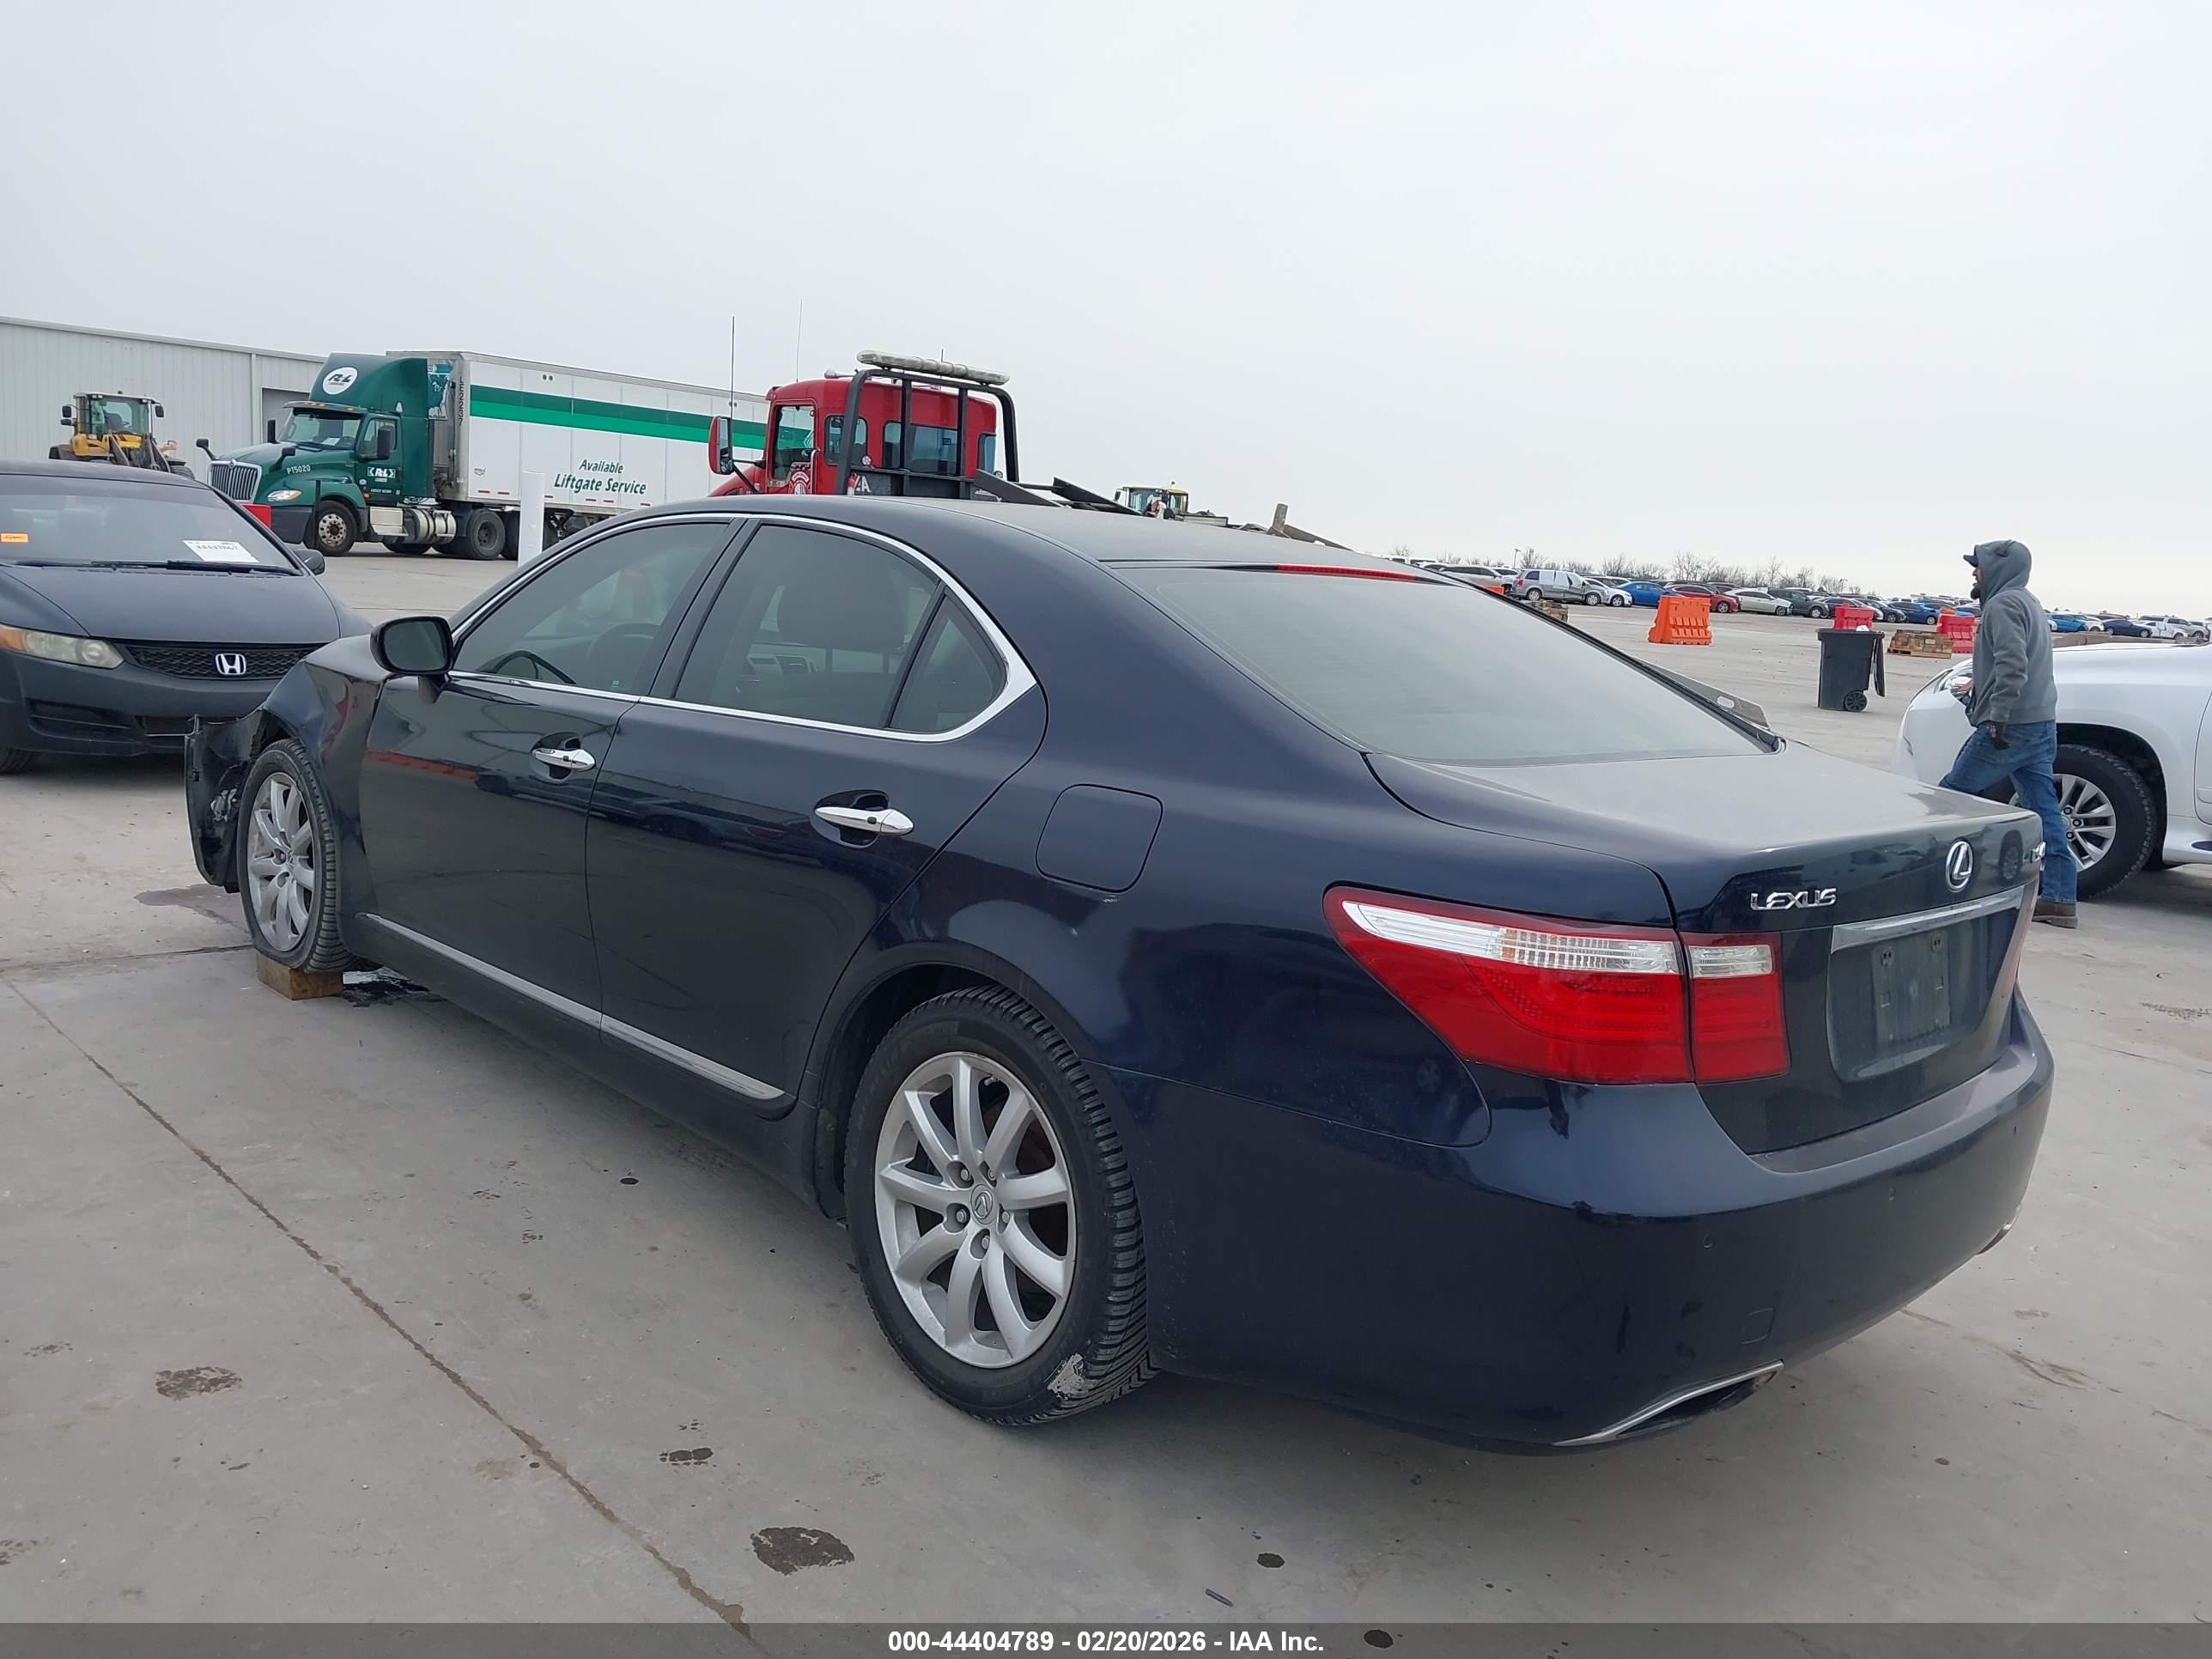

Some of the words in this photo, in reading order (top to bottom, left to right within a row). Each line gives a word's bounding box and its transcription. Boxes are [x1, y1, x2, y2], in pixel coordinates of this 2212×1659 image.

[579, 459, 623, 474] Available
[554, 473, 602, 494] Liftgate
[605, 477, 647, 495] Service
[1750, 888, 1837, 910] LEXUS
